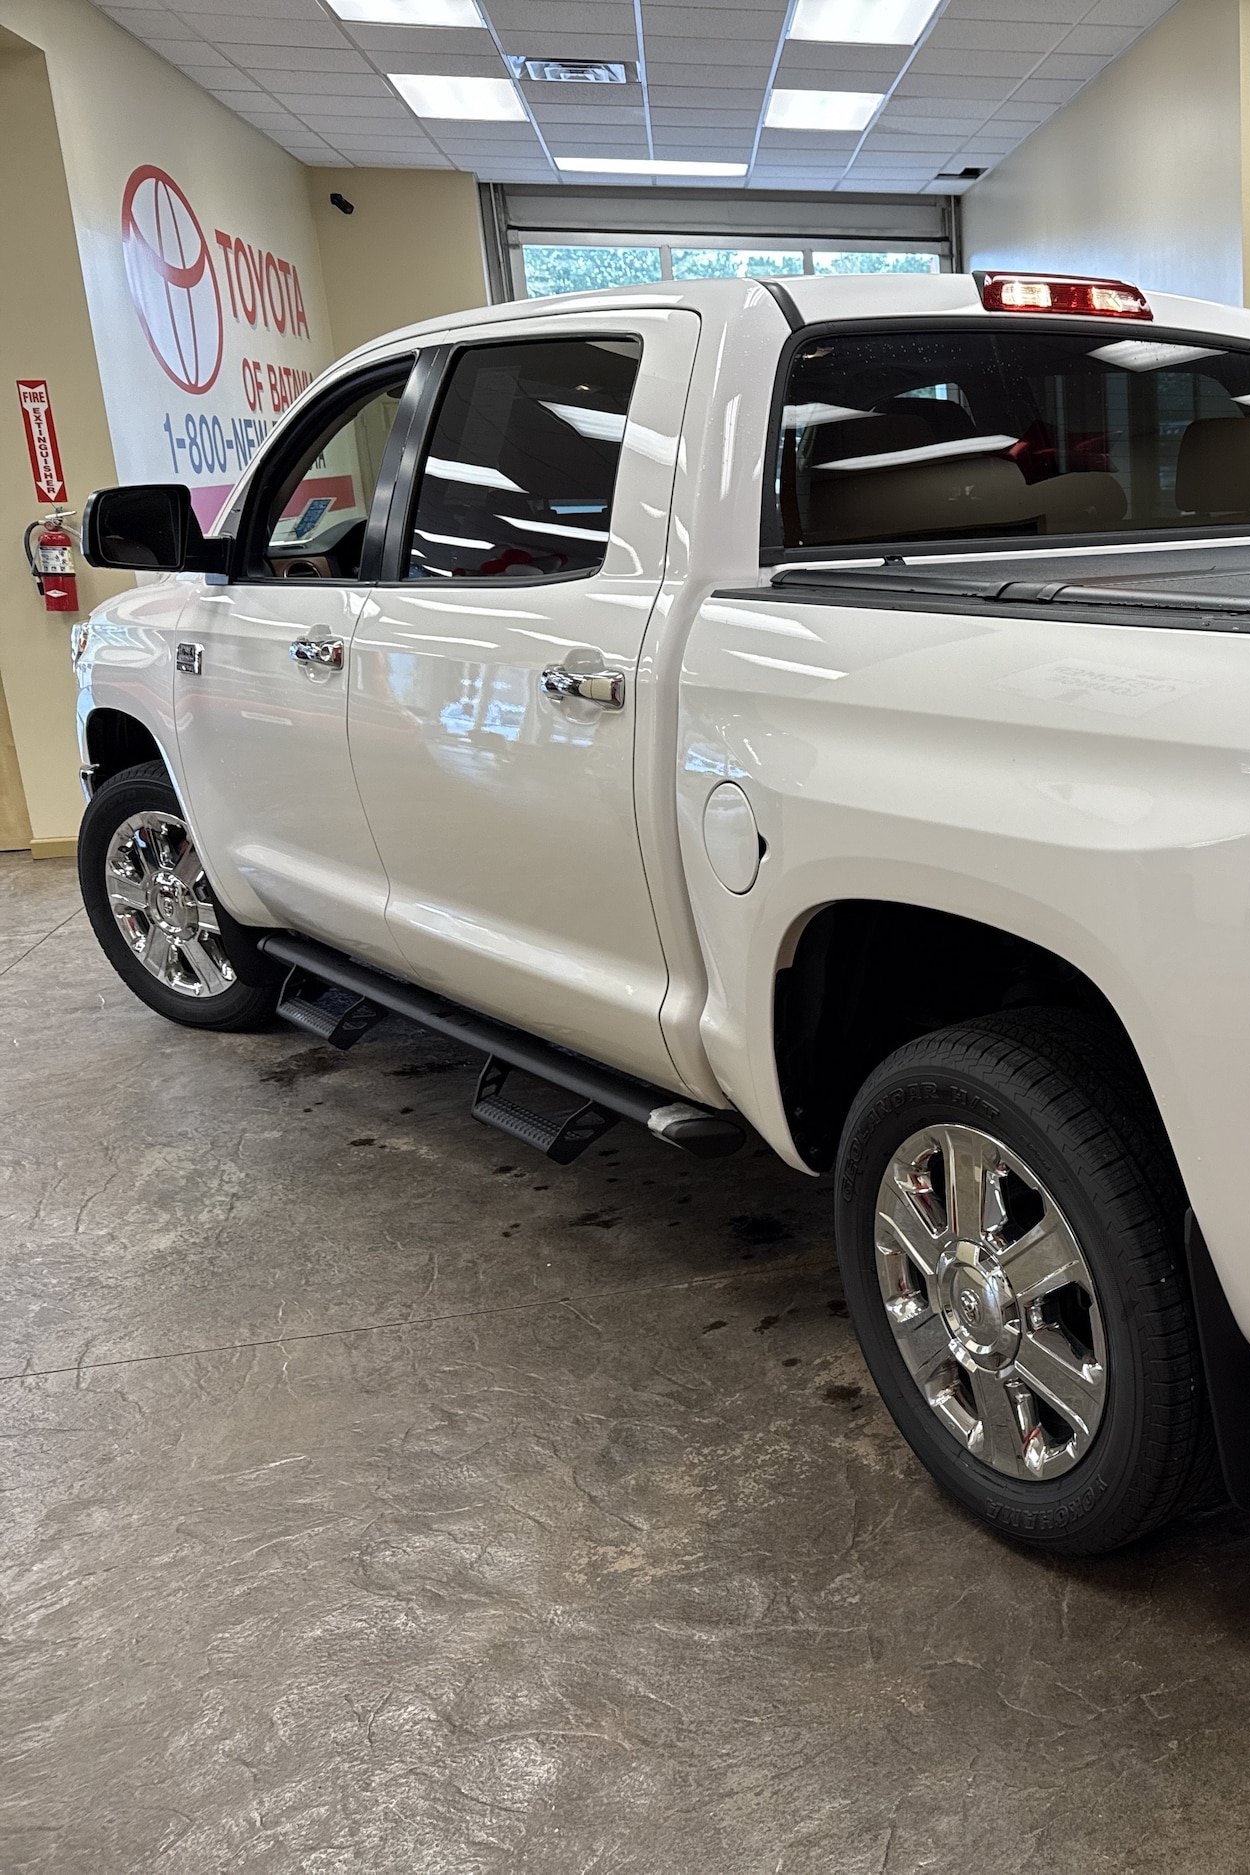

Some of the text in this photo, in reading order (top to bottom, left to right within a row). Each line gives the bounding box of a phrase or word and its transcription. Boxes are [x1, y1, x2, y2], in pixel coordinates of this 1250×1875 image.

[215, 229, 310, 340] TOYOTA
[22, 391, 46, 403] FIRE
[242, 358, 263, 412] OF
[32, 407, 56, 494] EXTINGUISHER
